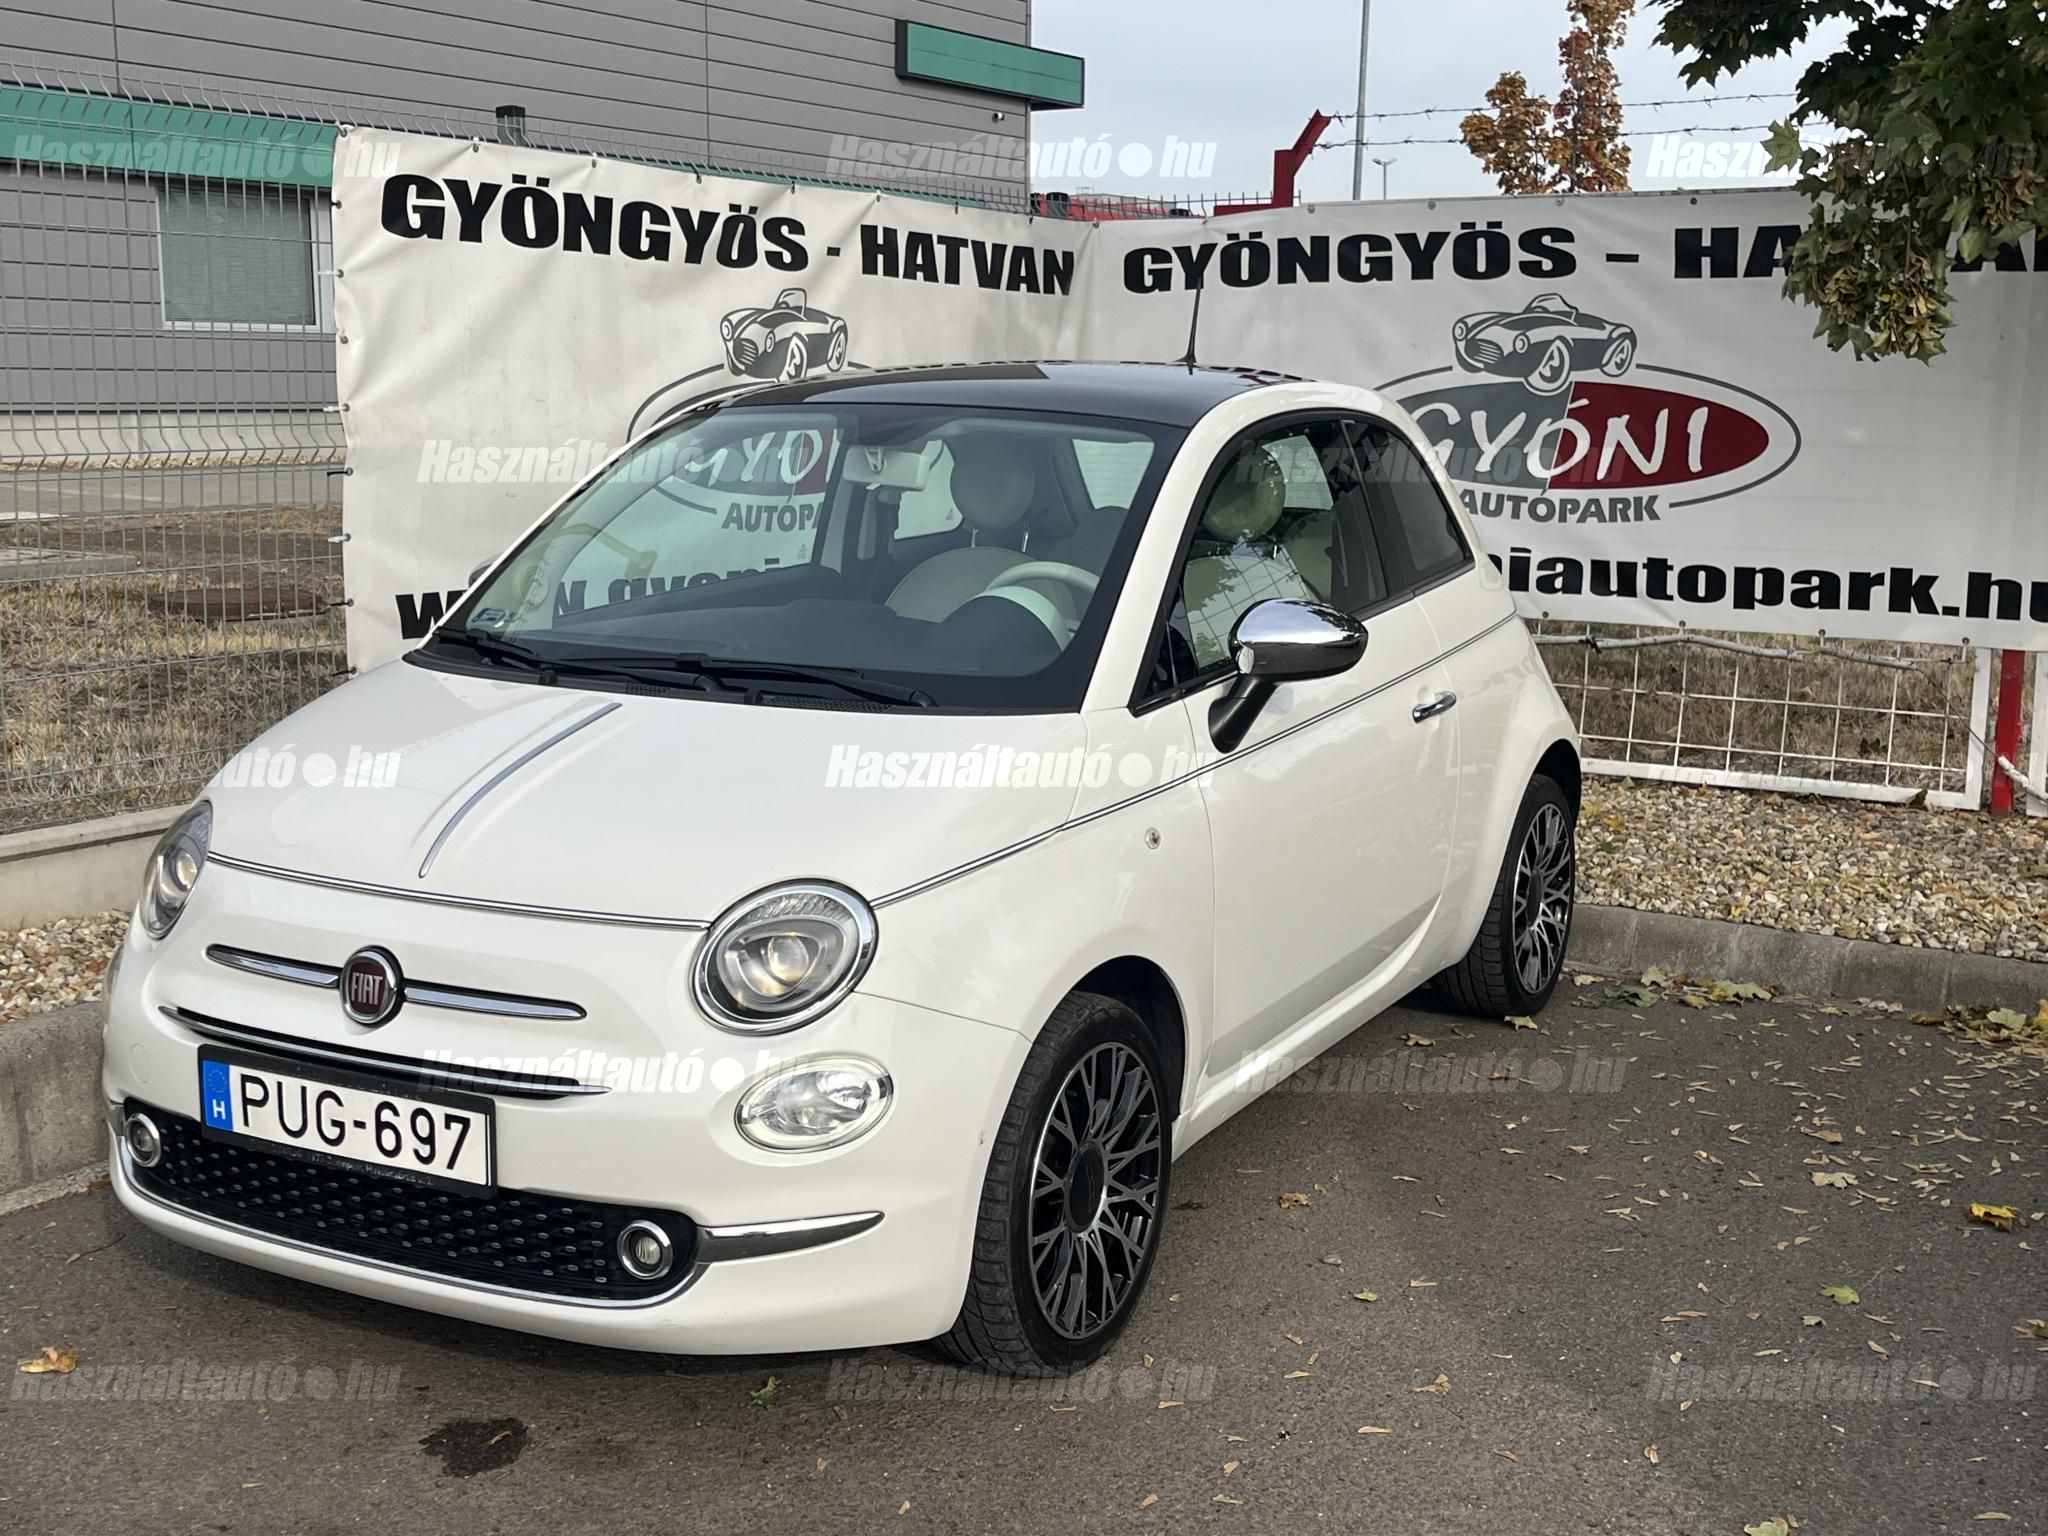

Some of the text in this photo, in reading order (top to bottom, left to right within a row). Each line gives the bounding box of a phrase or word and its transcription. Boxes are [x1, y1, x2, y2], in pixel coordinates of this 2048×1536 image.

[381, 173, 809, 272] GYÖNGYÖS
[860, 224, 1074, 296] HATVAN
[1123, 220, 1577, 293] GYÖNGYÖS
[1460, 488, 1661, 524] AUTÓPARK
[351, 971, 383, 1005] FIAT
[212, 1099, 226, 1120] H
[240, 1072, 471, 1170] PUG-697
